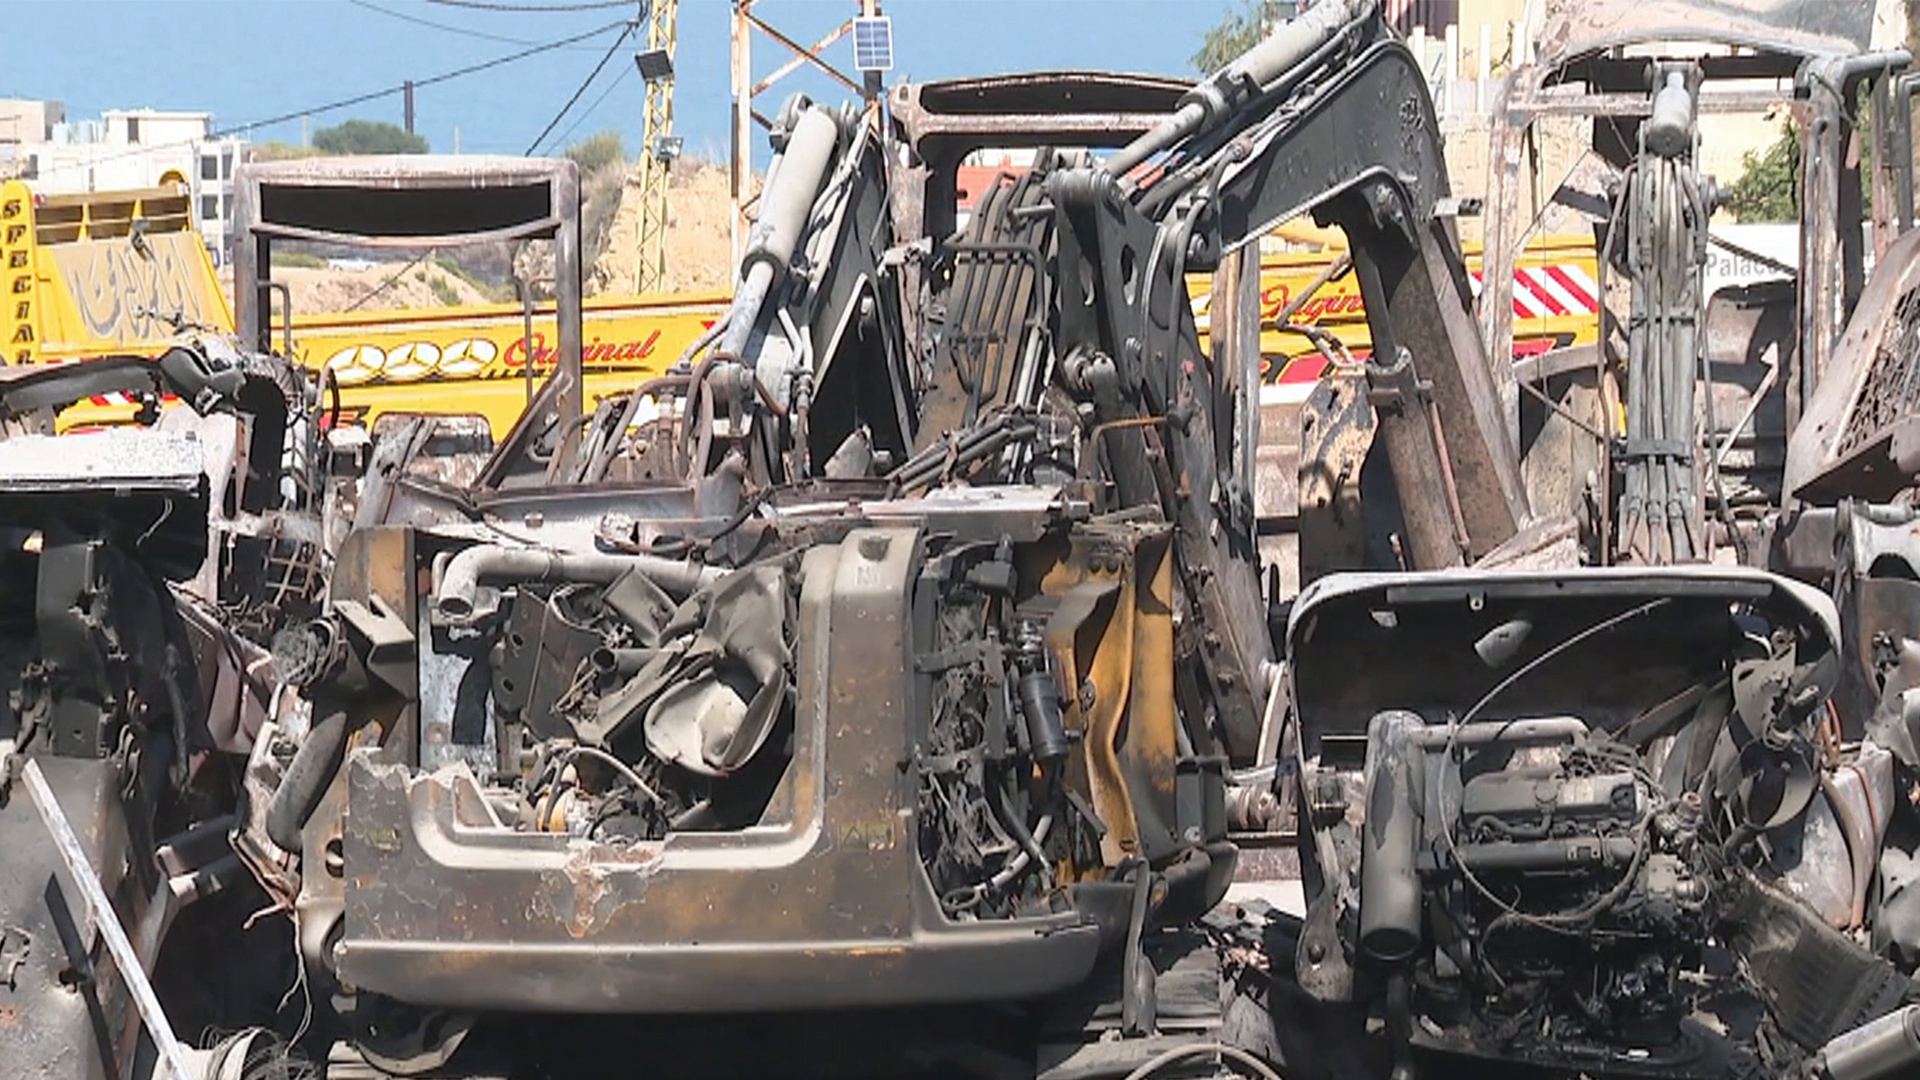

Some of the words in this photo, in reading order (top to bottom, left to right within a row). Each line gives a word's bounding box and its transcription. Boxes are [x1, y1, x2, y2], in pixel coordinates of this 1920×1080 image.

[2, 199, 35, 365] SPECIAL
[1260, 284, 1365, 324] Origin
[503, 329, 661, 371] Oriinal
